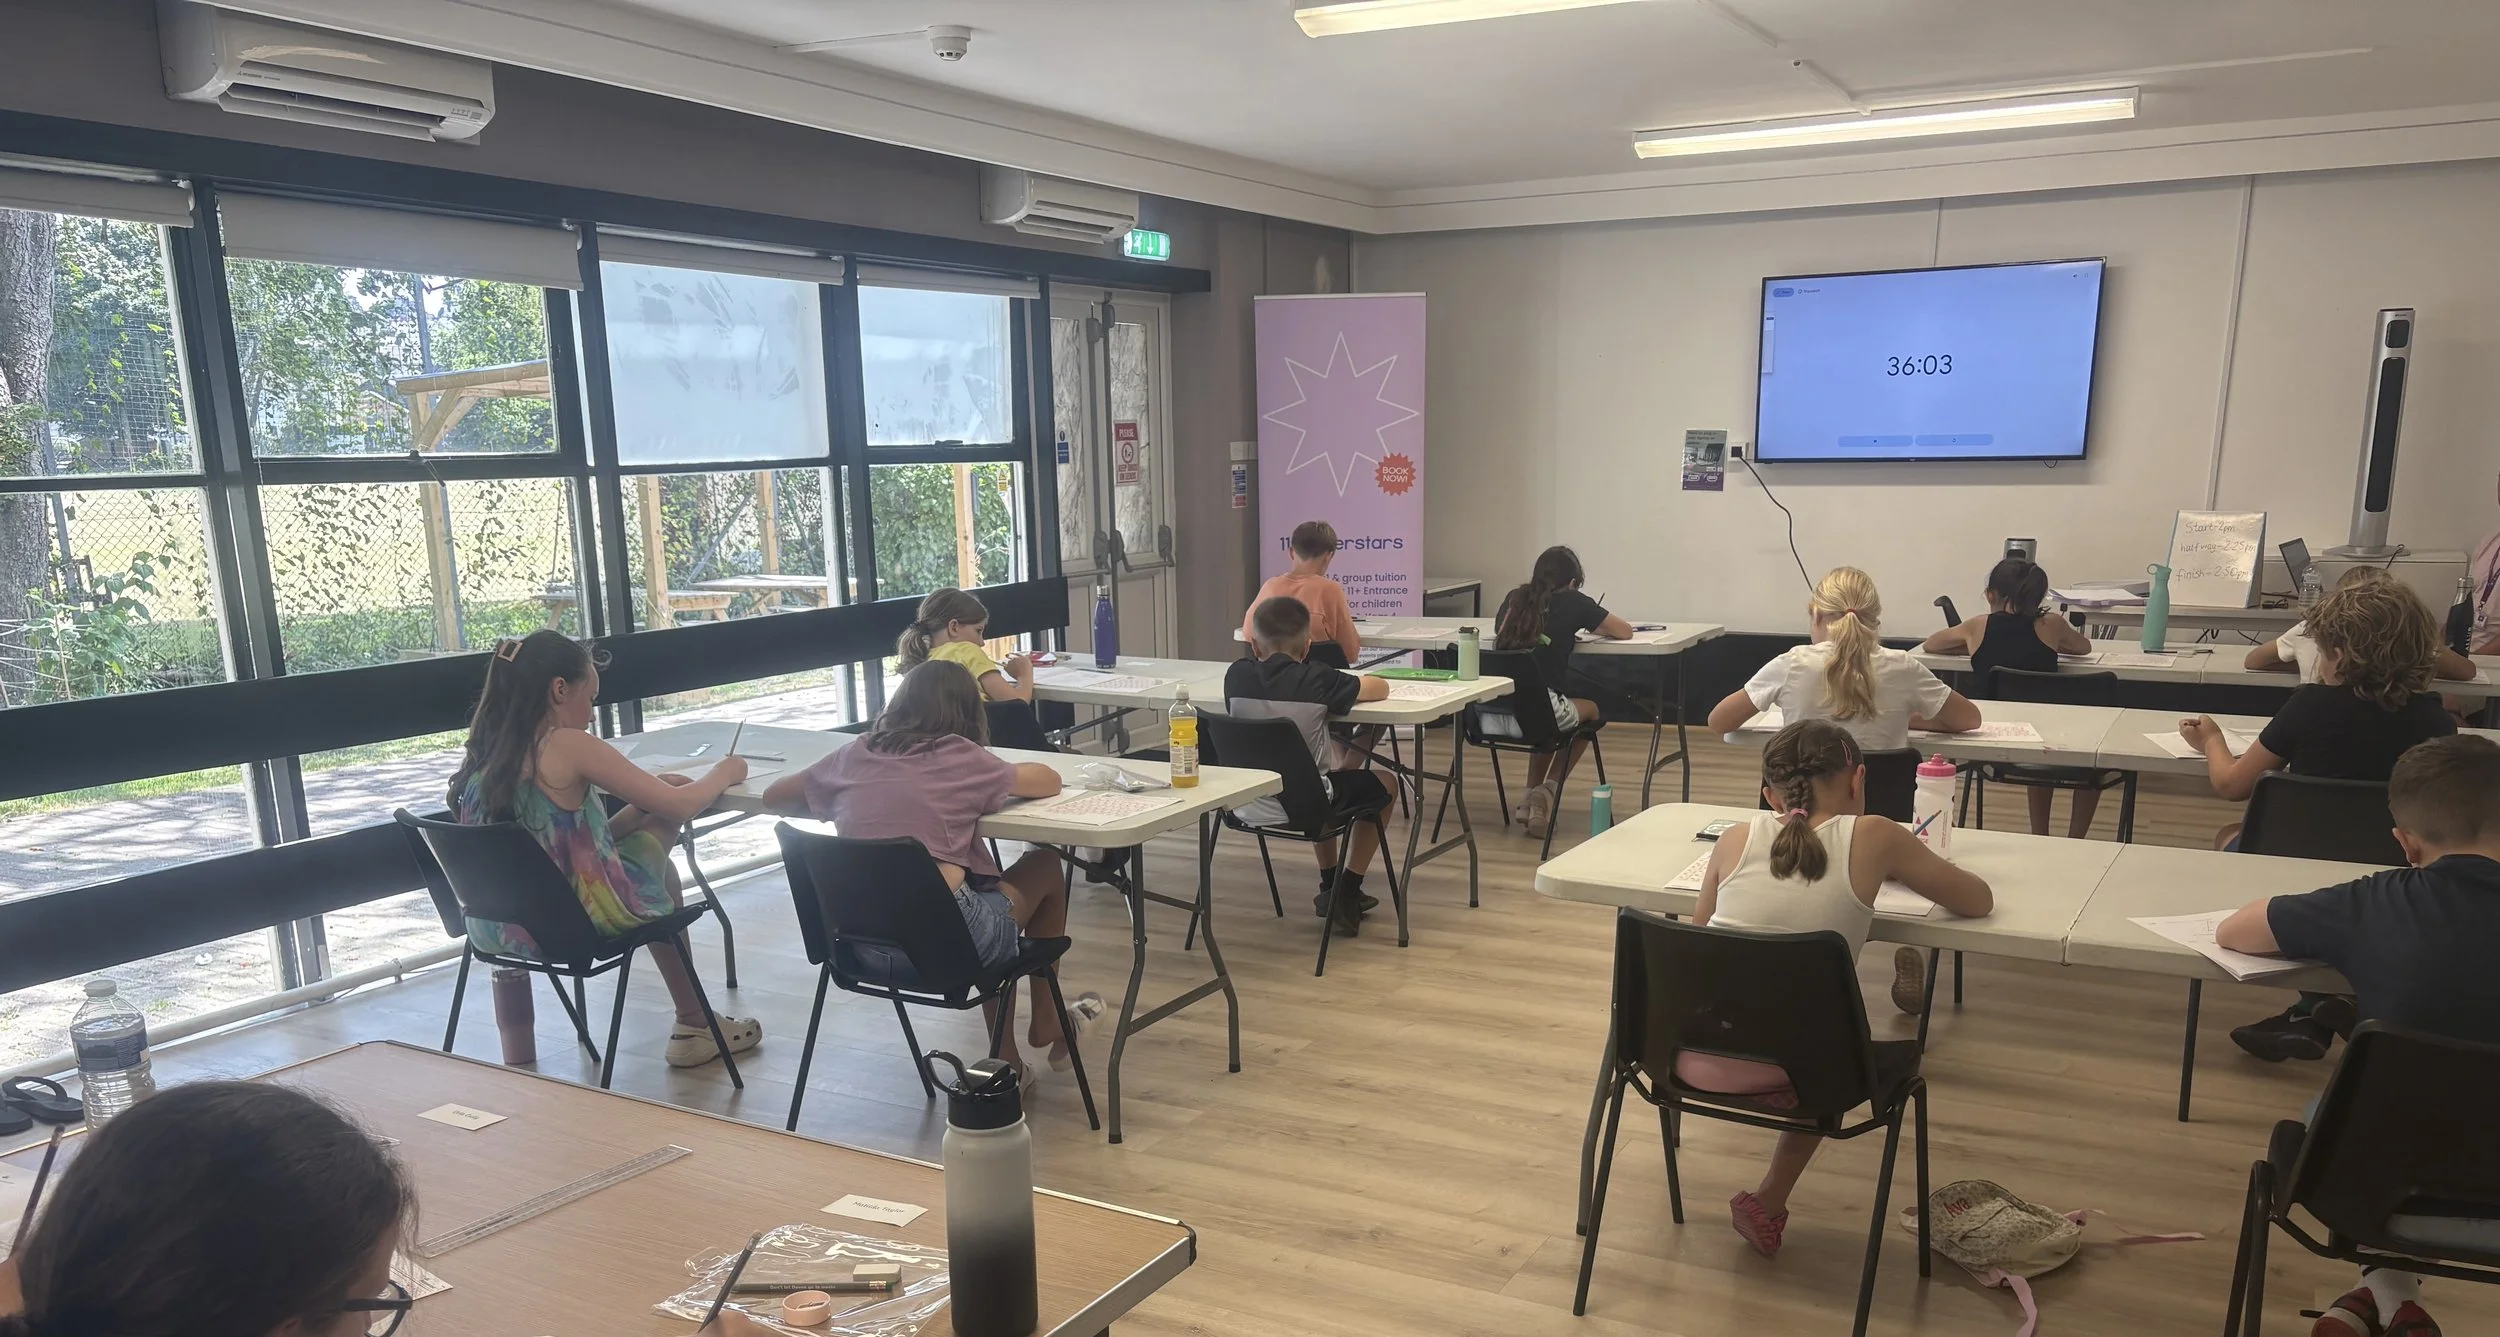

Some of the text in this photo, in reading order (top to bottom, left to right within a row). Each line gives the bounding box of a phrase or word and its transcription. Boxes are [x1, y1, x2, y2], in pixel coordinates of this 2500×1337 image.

[1887, 354, 1952, 376] 36:03
[1382, 466, 1409, 475] BOOK
[1336, 536, 1404, 550] erstars
[1342, 575, 1372, 585] group
[1375, 572, 1407, 582] tuition
[1347, 587, 1363, 596] 11+
[1363, 586, 1408, 596] Entrance
[1361, 599, 1403, 609] children
